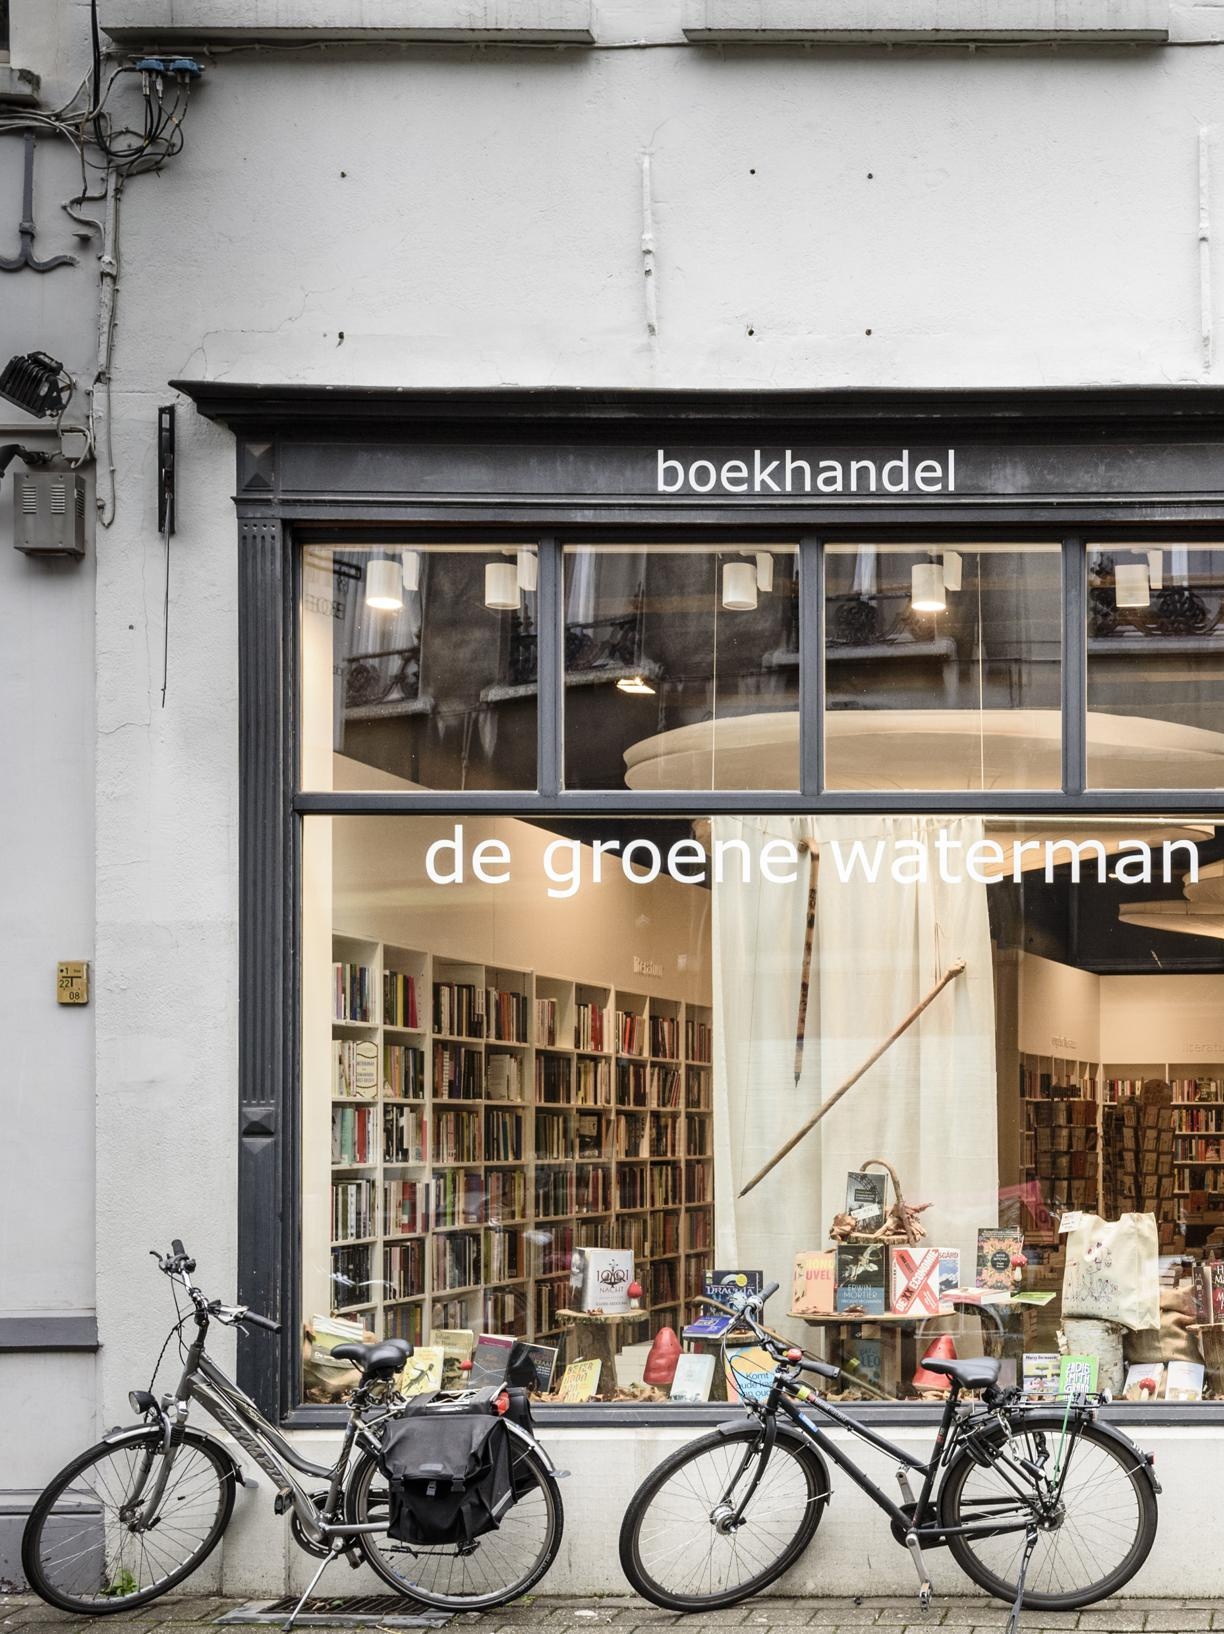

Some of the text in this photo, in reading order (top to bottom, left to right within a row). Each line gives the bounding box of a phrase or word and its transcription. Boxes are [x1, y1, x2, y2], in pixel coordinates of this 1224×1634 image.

[657, 449, 955, 492] boekhandel
[425, 824, 1199, 898] de groene waterman
